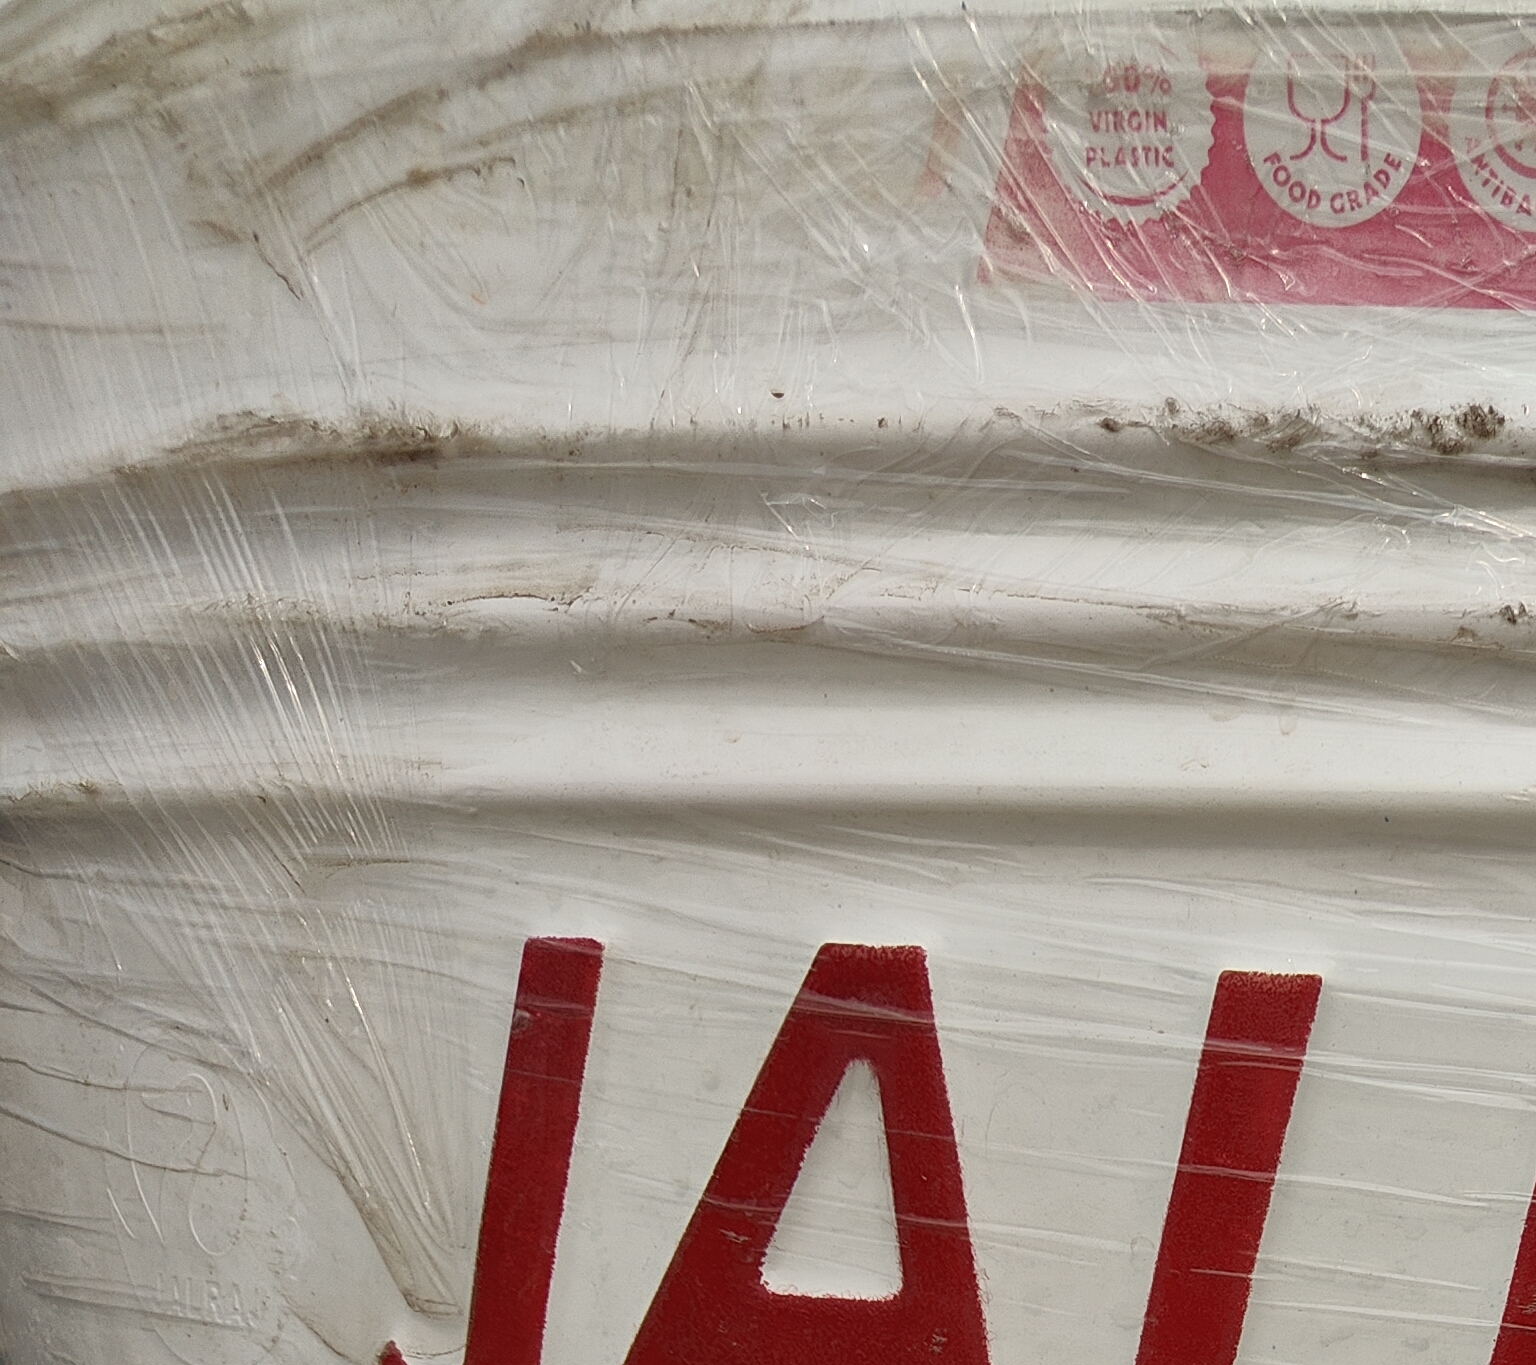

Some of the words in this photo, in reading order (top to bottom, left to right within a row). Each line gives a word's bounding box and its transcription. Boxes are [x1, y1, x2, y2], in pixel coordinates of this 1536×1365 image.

[1089, 110, 1168, 133] VIRGIN
[1085, 145, 1175, 168] PLASTIC
[1263, 151, 1322, 210] FOOD
[1329, 151, 1403, 215] GRADE
